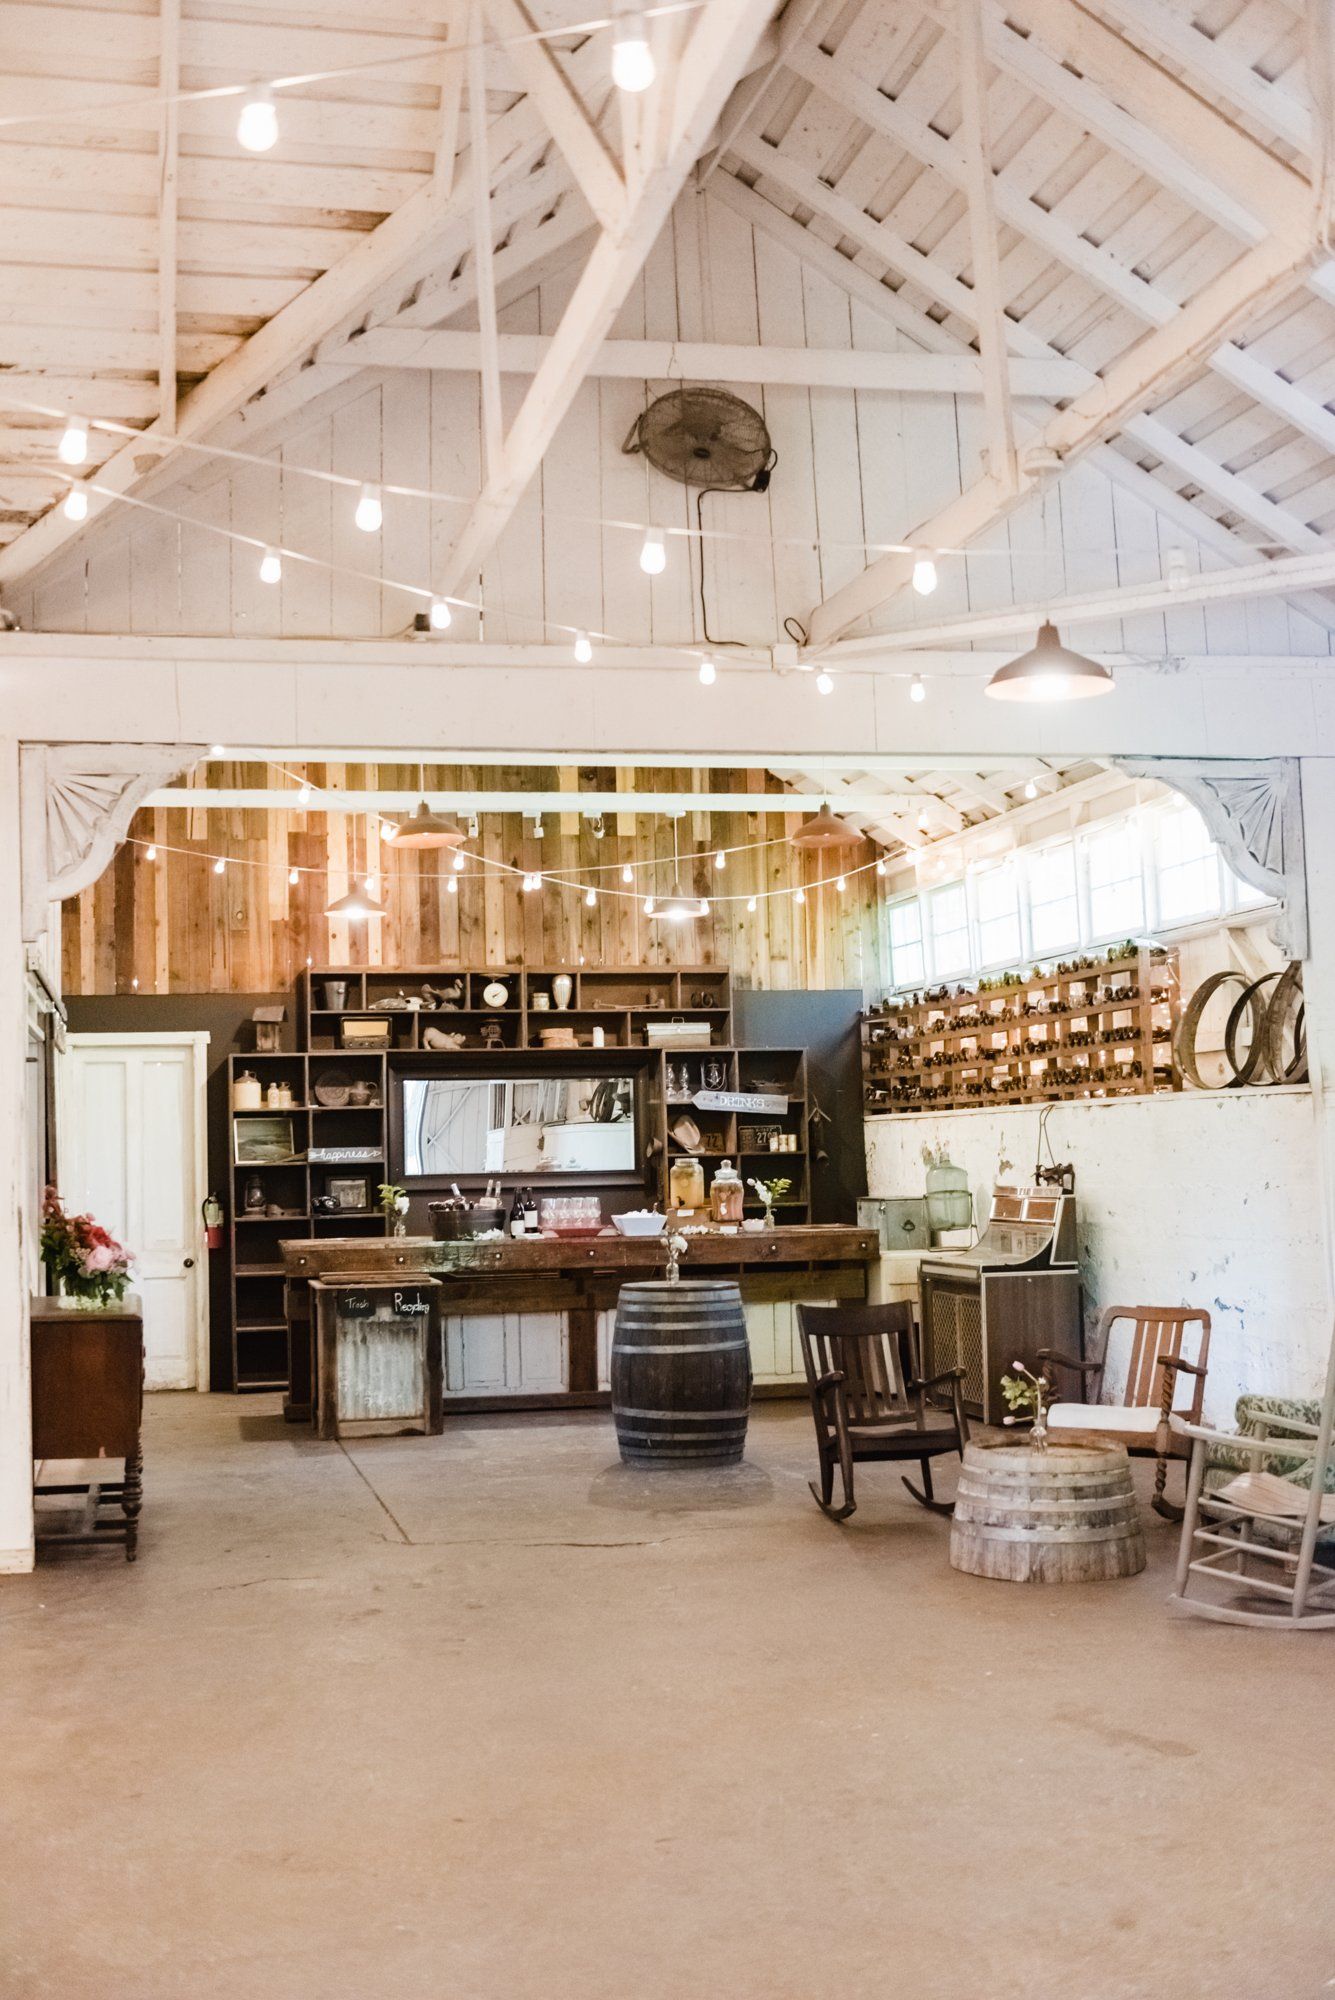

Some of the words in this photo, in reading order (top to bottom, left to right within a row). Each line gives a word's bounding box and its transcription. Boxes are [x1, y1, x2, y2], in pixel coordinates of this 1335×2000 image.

[719, 1095, 766, 1109] DRINKS
[319, 1148, 368, 1162] happiness
[345, 1296, 369, 1309] Trash
[394, 1292, 430, 1315] Recycling
